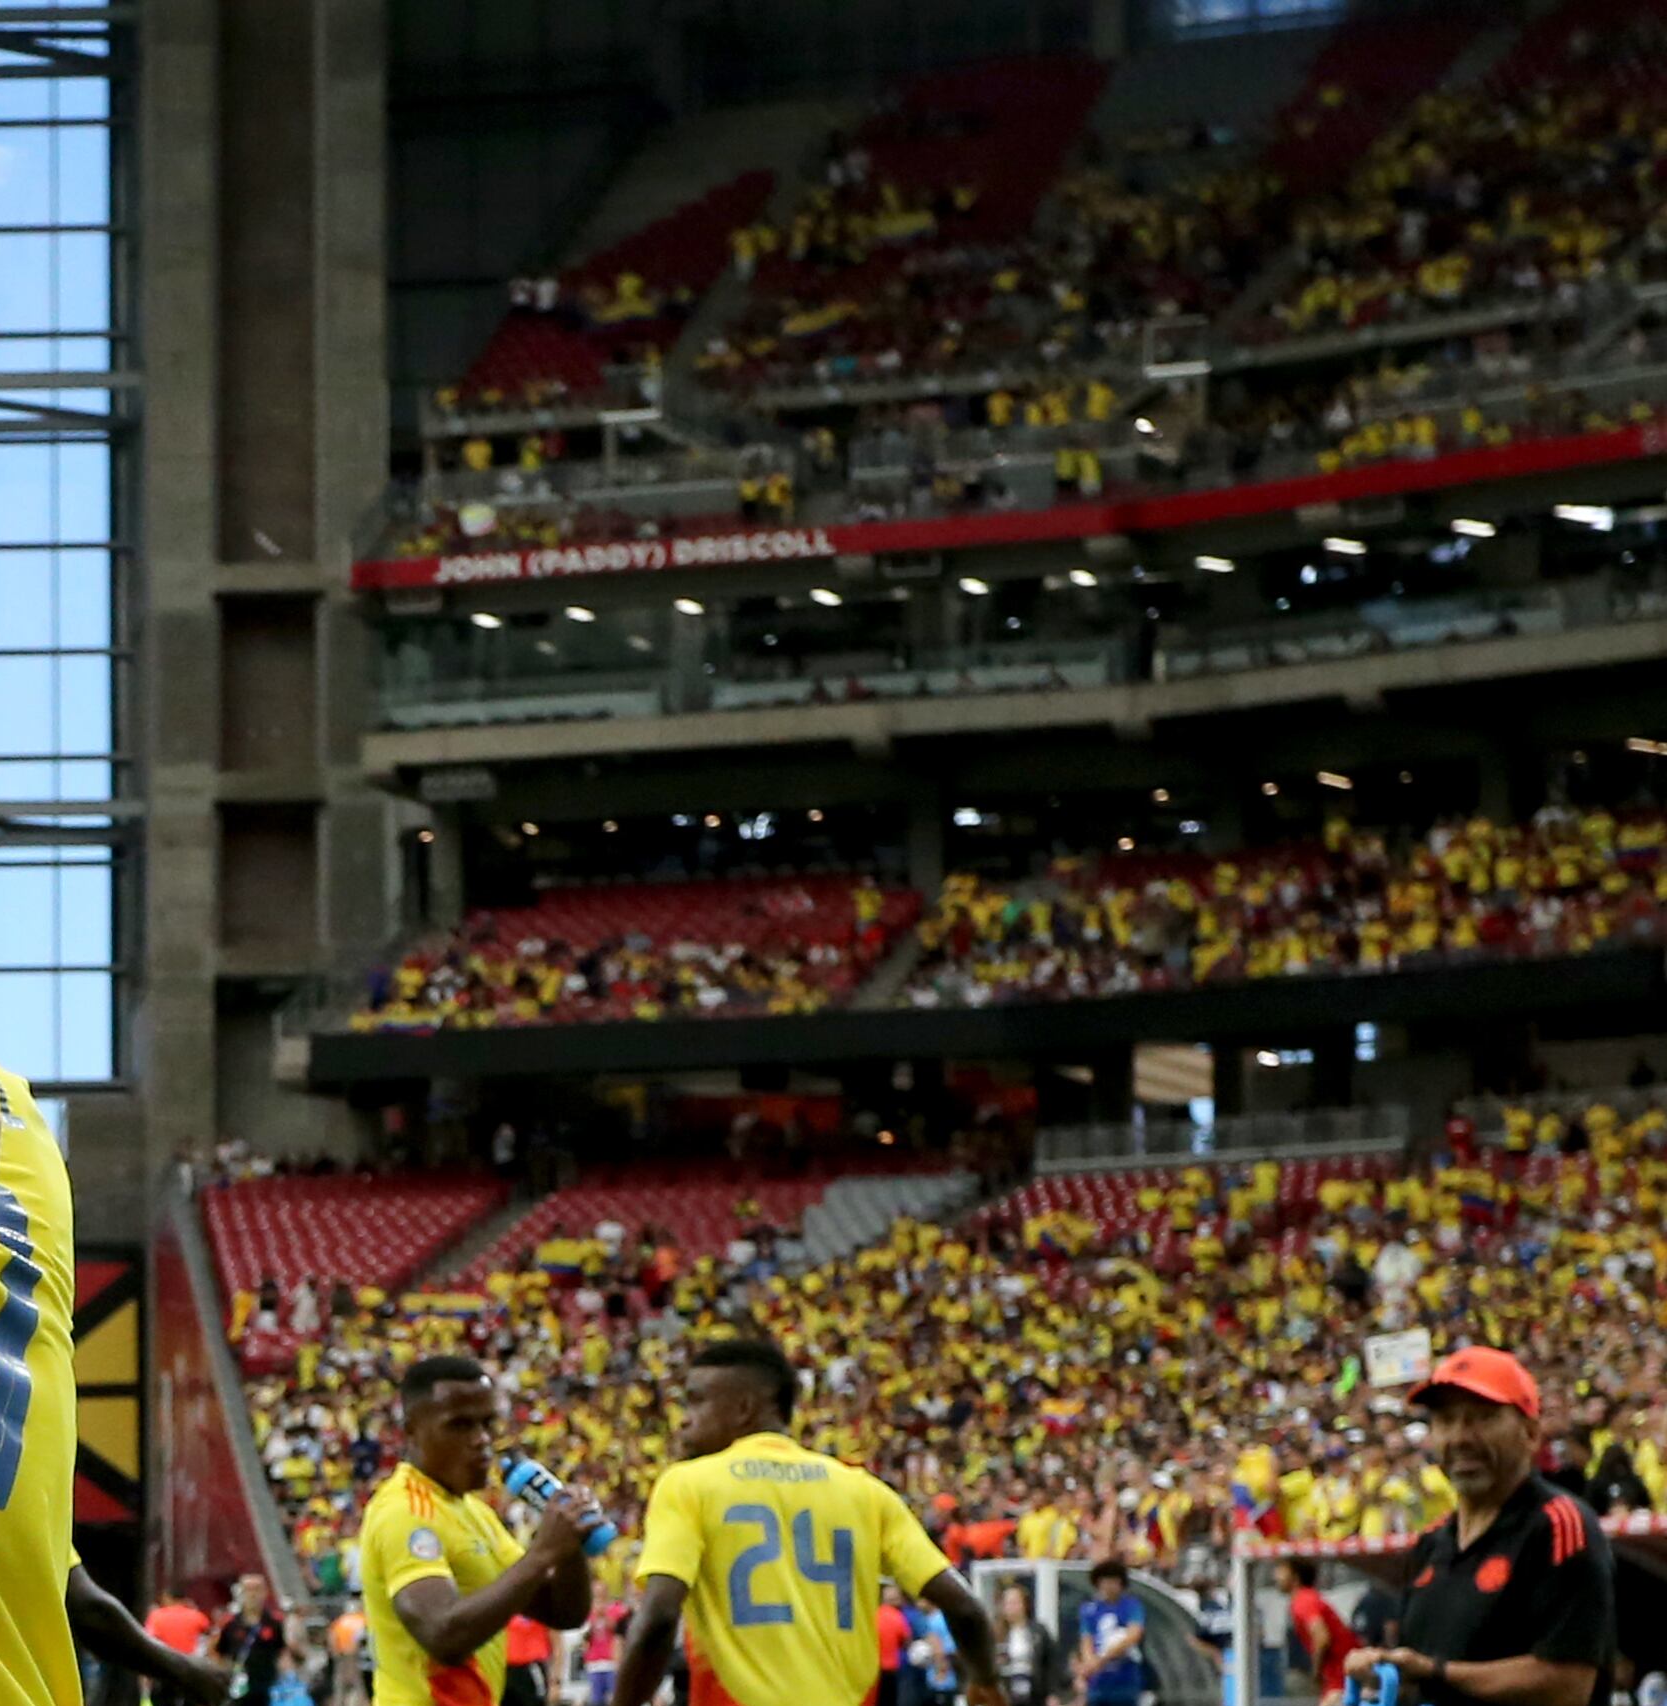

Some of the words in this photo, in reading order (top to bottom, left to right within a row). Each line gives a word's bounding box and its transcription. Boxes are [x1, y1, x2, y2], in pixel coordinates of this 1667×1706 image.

[434, 554, 522, 583] JOHN
[527, 541, 667, 577] (PADDY)
[672, 530, 836, 566] DRISCOLL
[723, 1503, 855, 1632] 24
